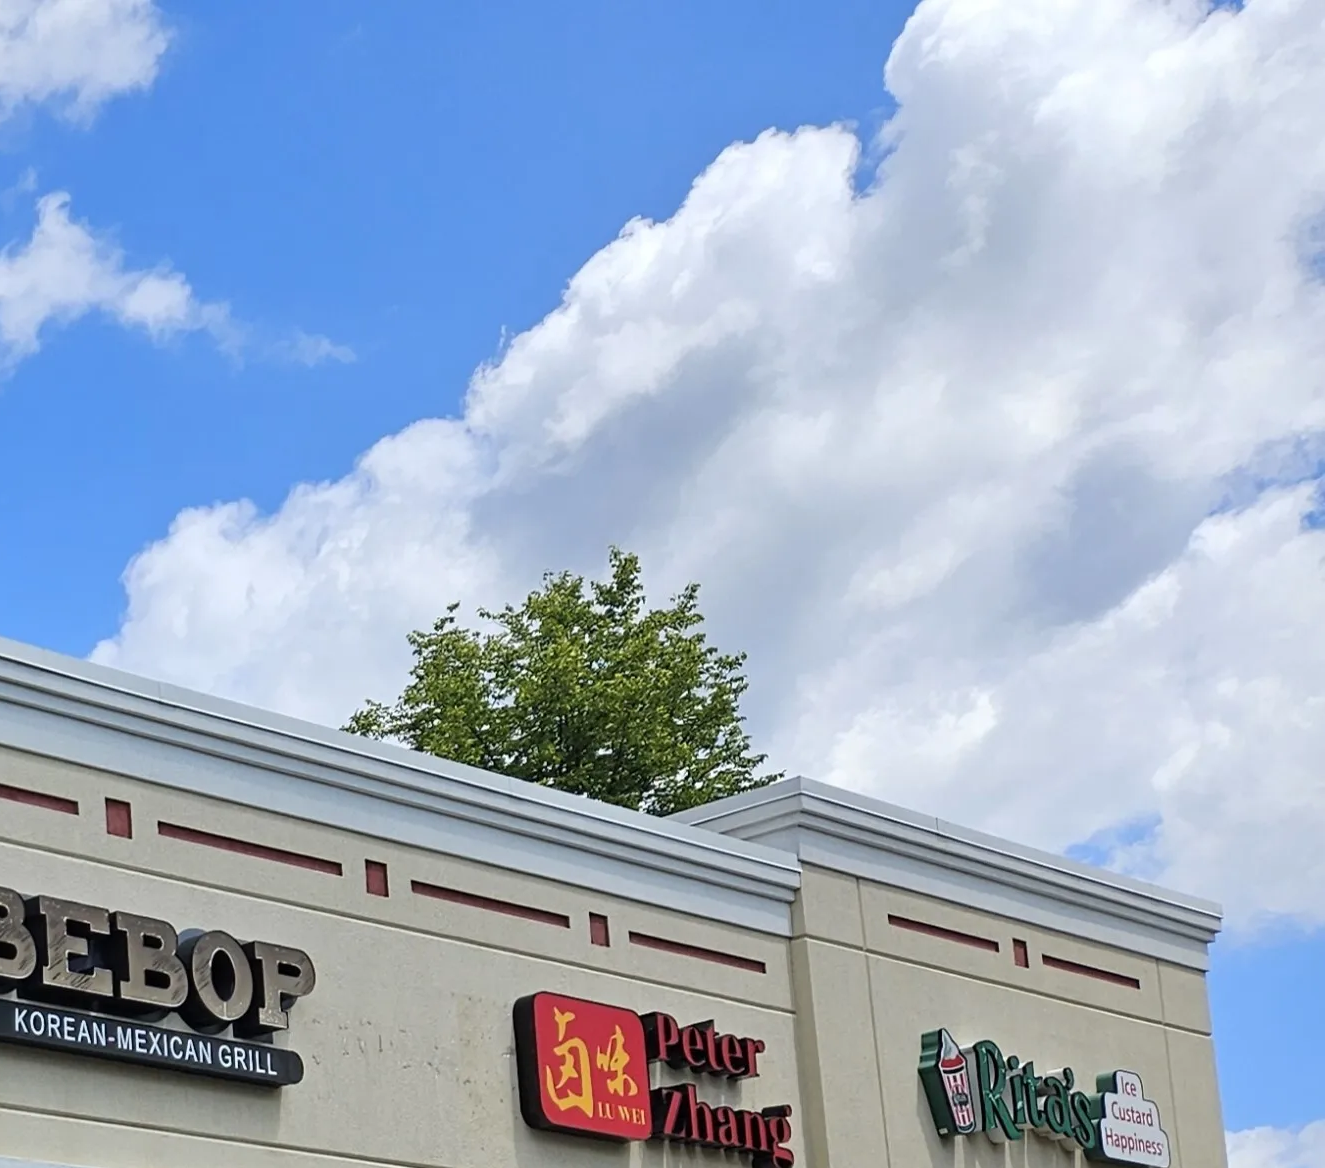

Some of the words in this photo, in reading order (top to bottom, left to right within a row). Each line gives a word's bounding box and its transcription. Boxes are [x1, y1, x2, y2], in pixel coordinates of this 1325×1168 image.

[13, 1006, 214, 1066] KOREAN-MEXICAN
[218, 1044, 279, 1077] GRILL
[647, 1012, 766, 1079] Peter
[973, 1039, 1096, 1150] Rita's
[1120, 1075, 1137, 1098] Ice
[597, 1101, 616, 1120] LU
[618, 1104, 647, 1126] WEI
[1111, 1101, 1154, 1128] Custard
[1105, 1126, 1163, 1157] Happiness
